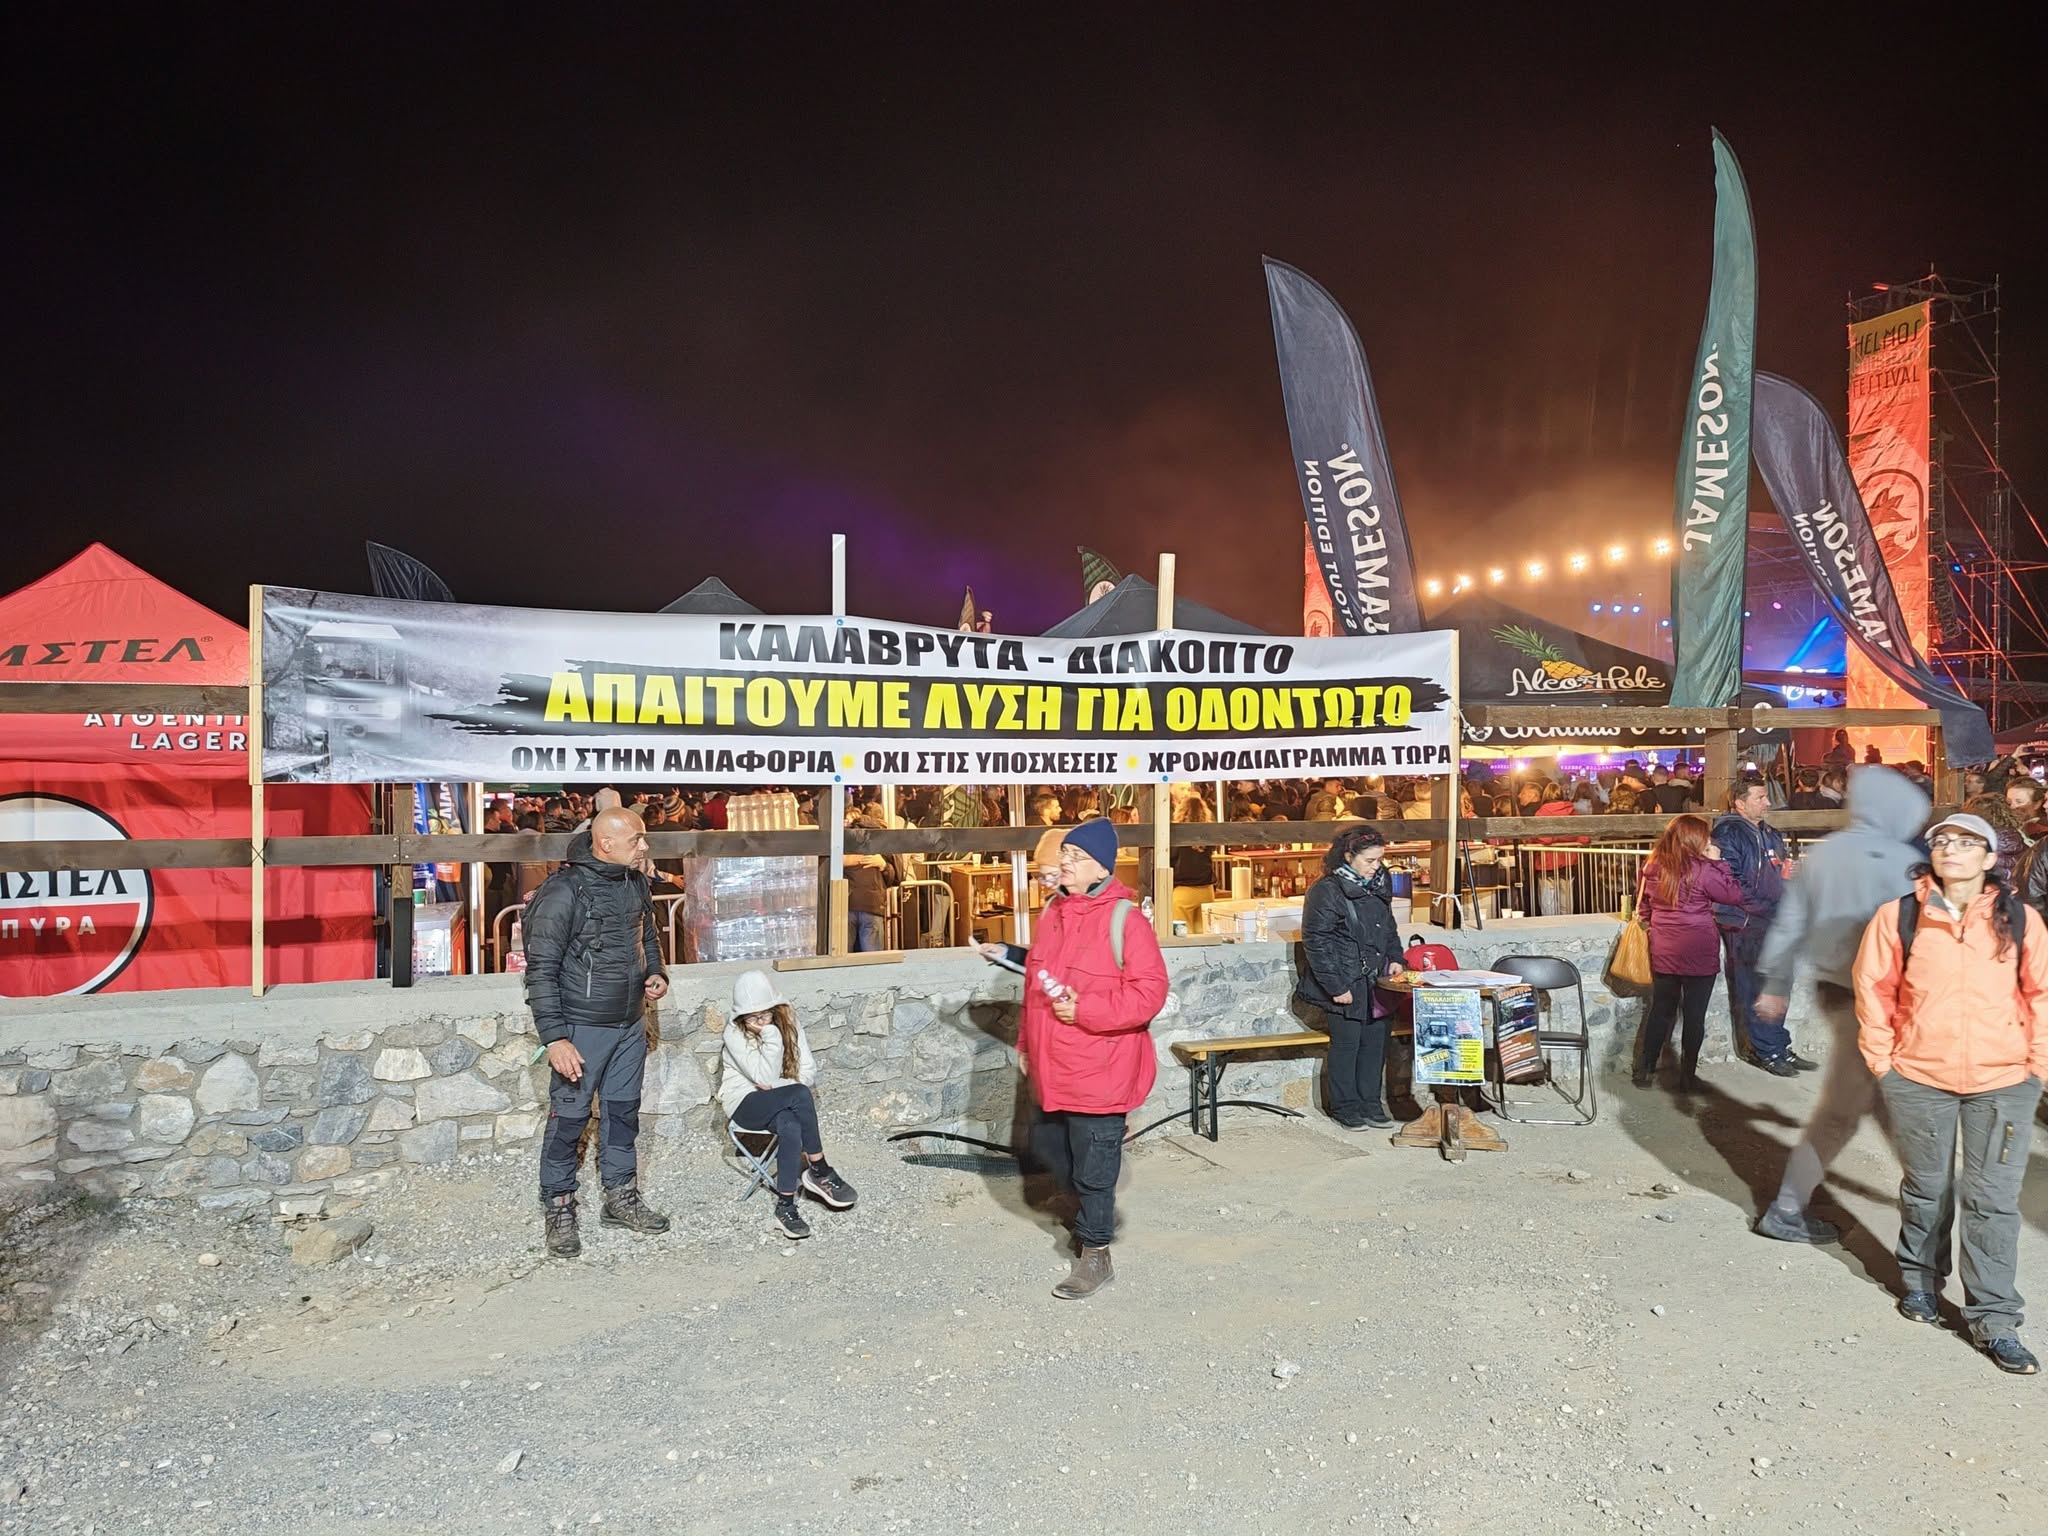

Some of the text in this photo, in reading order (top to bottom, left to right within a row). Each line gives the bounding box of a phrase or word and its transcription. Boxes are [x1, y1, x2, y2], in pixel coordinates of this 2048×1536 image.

[1855, 319, 1922, 358] HELMOS
[1853, 365, 1920, 398] FESTIVAL
[719, 622, 1029, 672] ΚΑΛΑΒΡΥΤΑ
[1067, 639, 1295, 674] ΔΙΑΚΟΠΤΟ
[542, 672, 1413, 732] ΑΠΑΙΤΟΥΜΕ ΛΥΣΗ ΓΙΑ ΟΔΟΝΤΩΤΟ
[130, 732, 248, 750] LAGER
[511, 745, 1451, 774] ΟΧΙ ΣΤΗΝ ΑΔΙΑΦΟΡΙΑ ΟΧΙ ΣΤΙΣ ΥΠΟΣΧΕΣΕΙΣ ΧΡΟΝΟΔΙΑΓΡΑΜΜΑ ΤΩΡΑ
